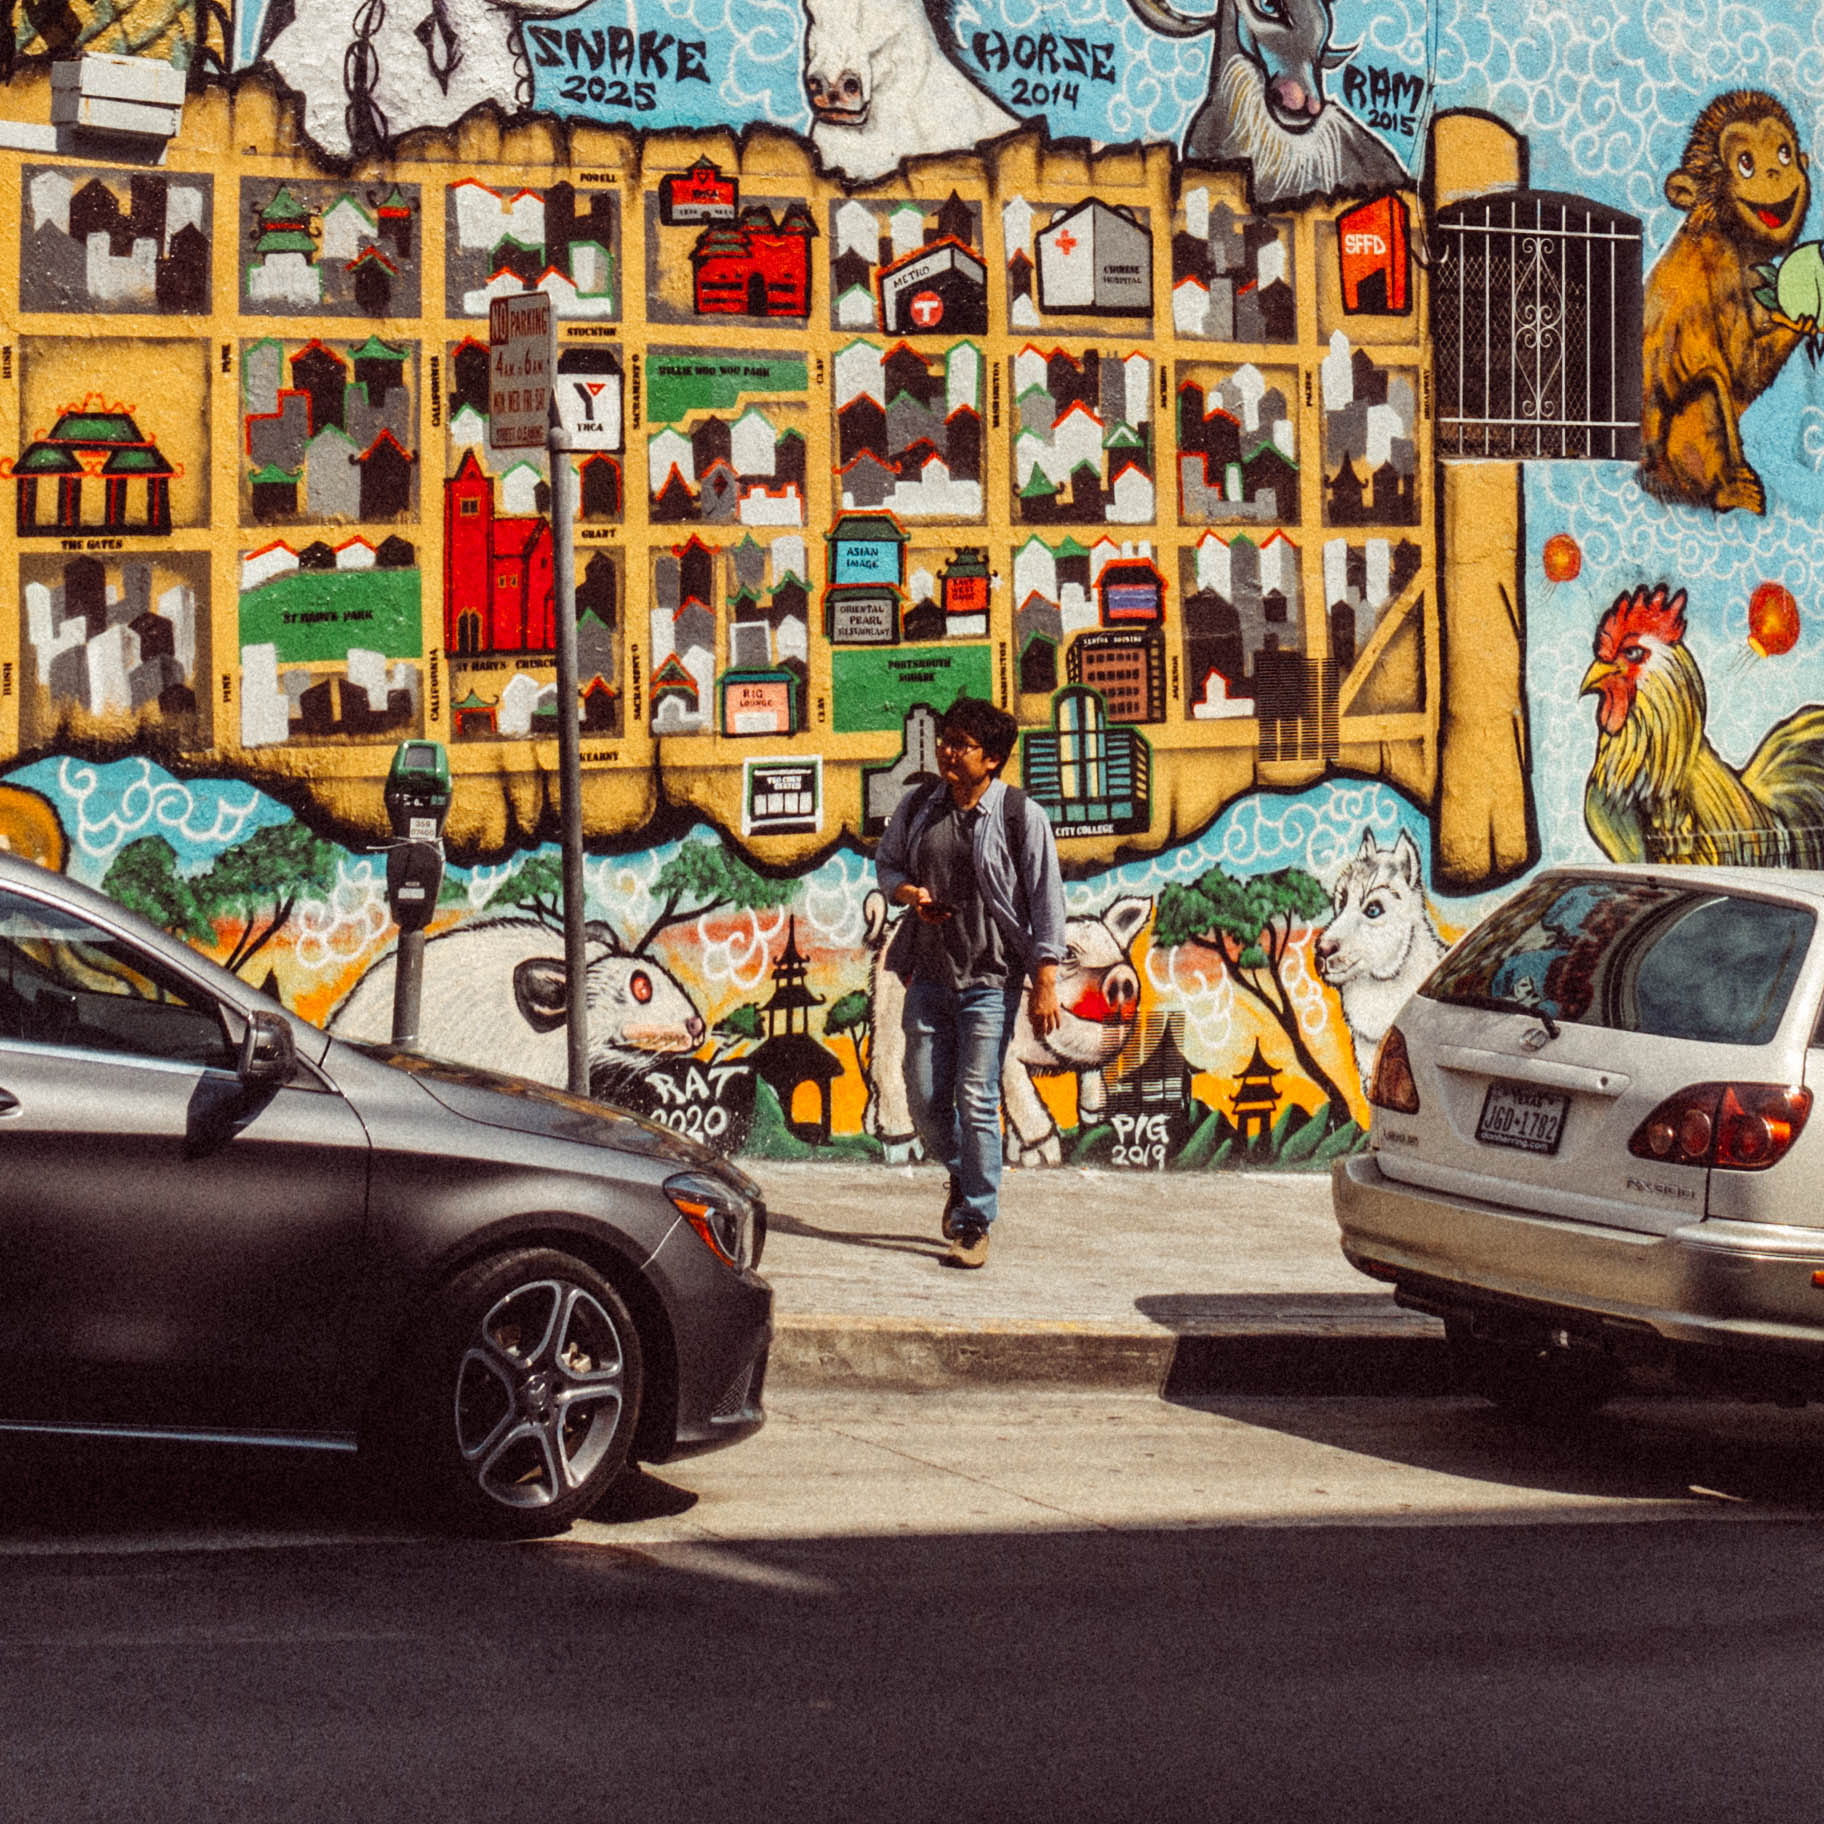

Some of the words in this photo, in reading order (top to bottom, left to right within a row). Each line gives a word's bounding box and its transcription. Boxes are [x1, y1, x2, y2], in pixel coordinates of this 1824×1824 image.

[528, 23, 710, 86] SNAKE
[974, 30, 1116, 81] HORSE
[561, 74, 658, 111] 2025
[1011, 78, 1081, 110] 2014
[1342, 62, 1426, 106] RAM
[1367, 107, 1416, 137] 2015
[1345, 234, 1386, 255] SFFD
[567, 327, 617, 337] STOCKTON
[431, 356, 440, 427] CALIFORNIA
[581, 528, 616, 539] GRANT
[847, 547, 879, 557] ASIAN
[847, 559, 879, 569] IMAGE
[840, 604, 885, 614] ORIENTAL
[849, 615, 882, 625] PEARL
[739, 699, 773, 708] LOUNGE
[1055, 826, 1076, 837] CITY
[1077, 824, 1114, 836] COLLEGE
[645, 1065, 749, 1106] RAT
[651, 1106, 728, 1139] 2020
[1111, 1114, 1169, 1144] PIG
[1110, 1143, 1167, 1170] 2019
